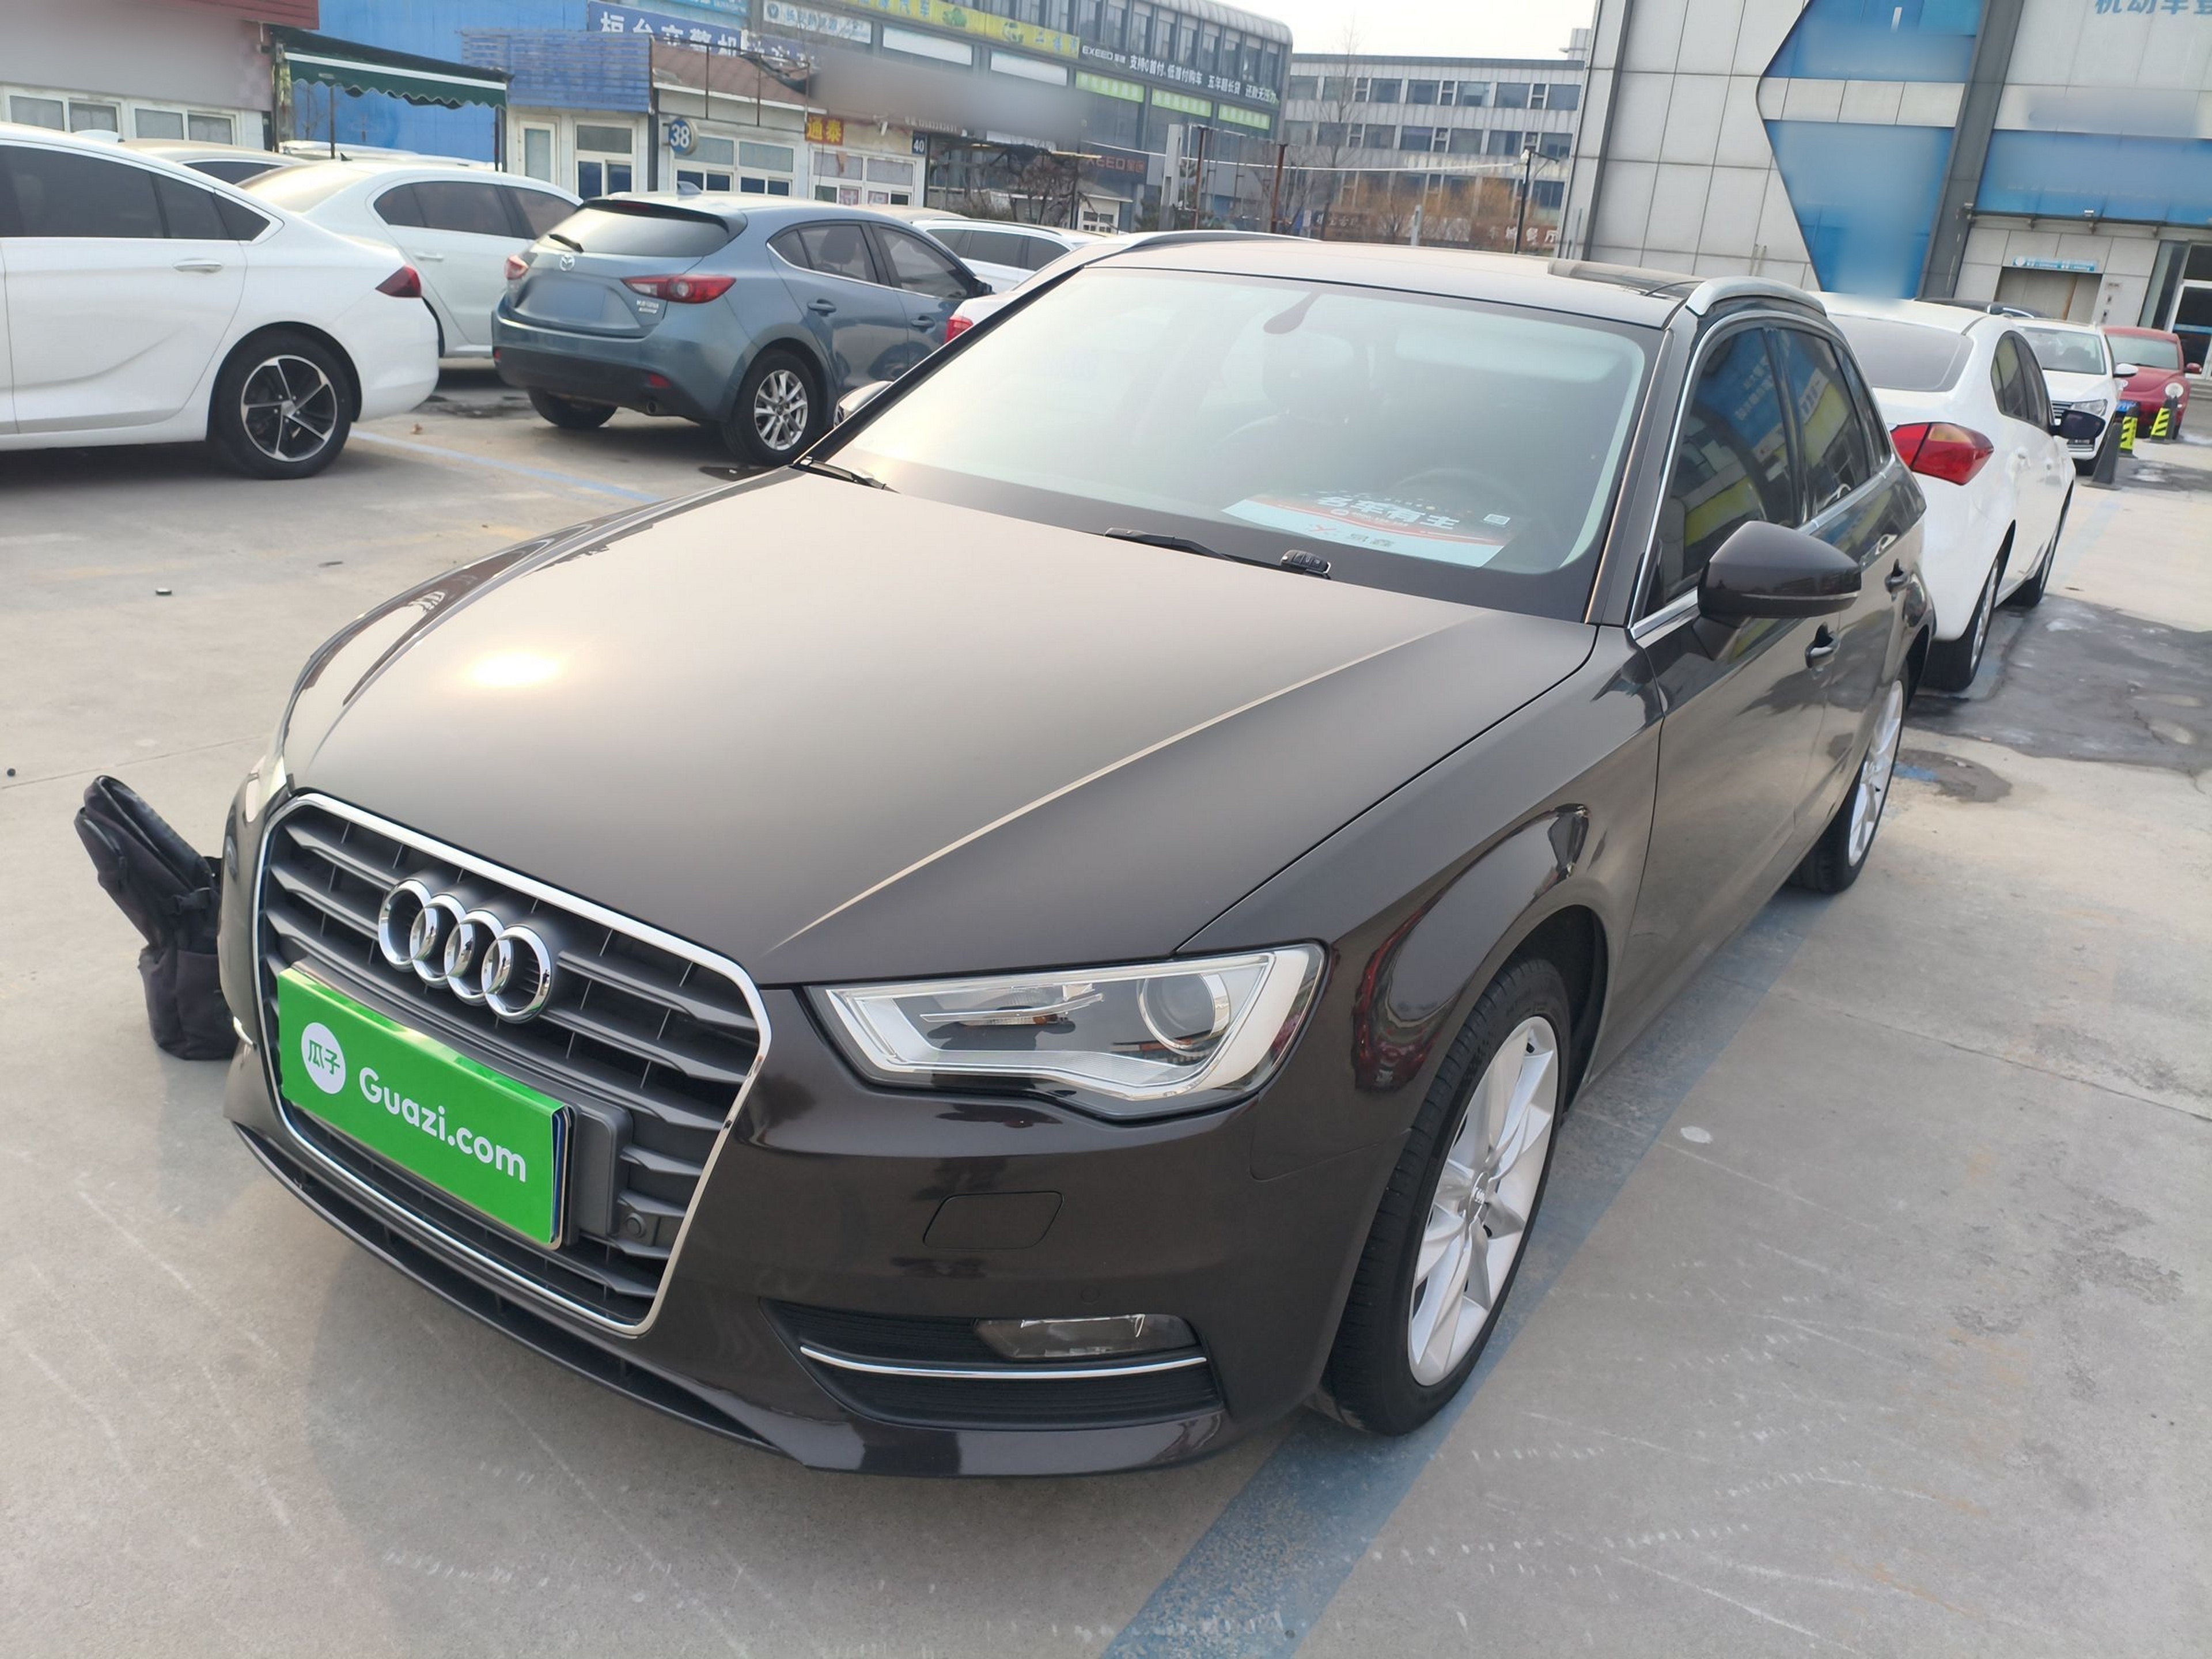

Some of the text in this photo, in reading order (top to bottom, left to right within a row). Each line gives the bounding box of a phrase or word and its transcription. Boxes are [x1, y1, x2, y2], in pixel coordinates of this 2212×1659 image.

[1082, 46, 1113, 60] EXEED
[670, 123, 690, 147] 38
[807, 118, 842, 142] 通泰
[913, 139, 925, 153] 40
[308, 1039, 340, 1075] 瓜子
[359, 1067, 527, 1183] Guazi.com
